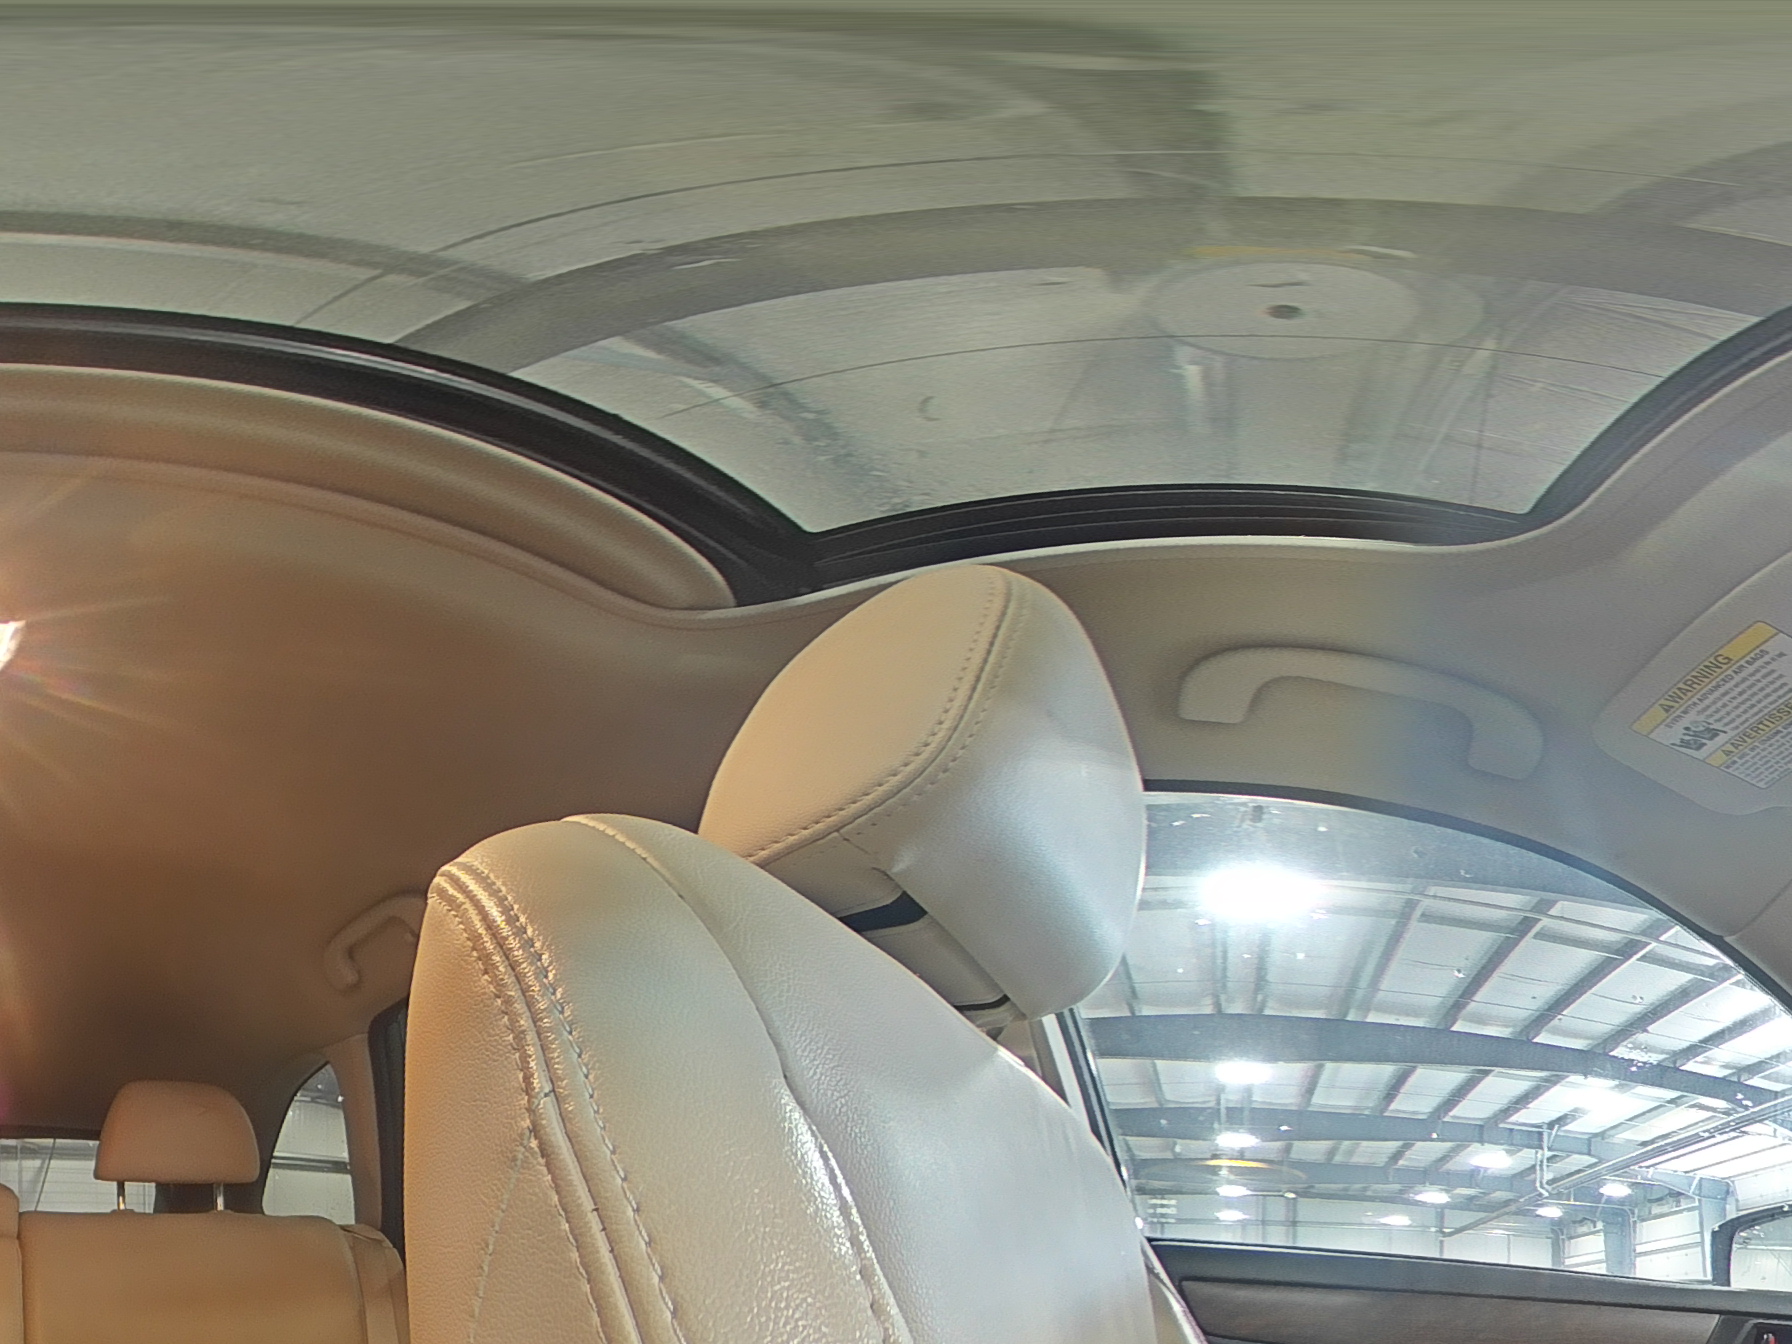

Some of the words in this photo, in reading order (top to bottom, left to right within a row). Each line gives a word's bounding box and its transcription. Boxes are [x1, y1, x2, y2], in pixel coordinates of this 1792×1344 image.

[1664, 653, 1735, 704] WARNING
[1697, 673, 1735, 702] ADVANCED
[1746, 649, 1770, 667] BAGS
